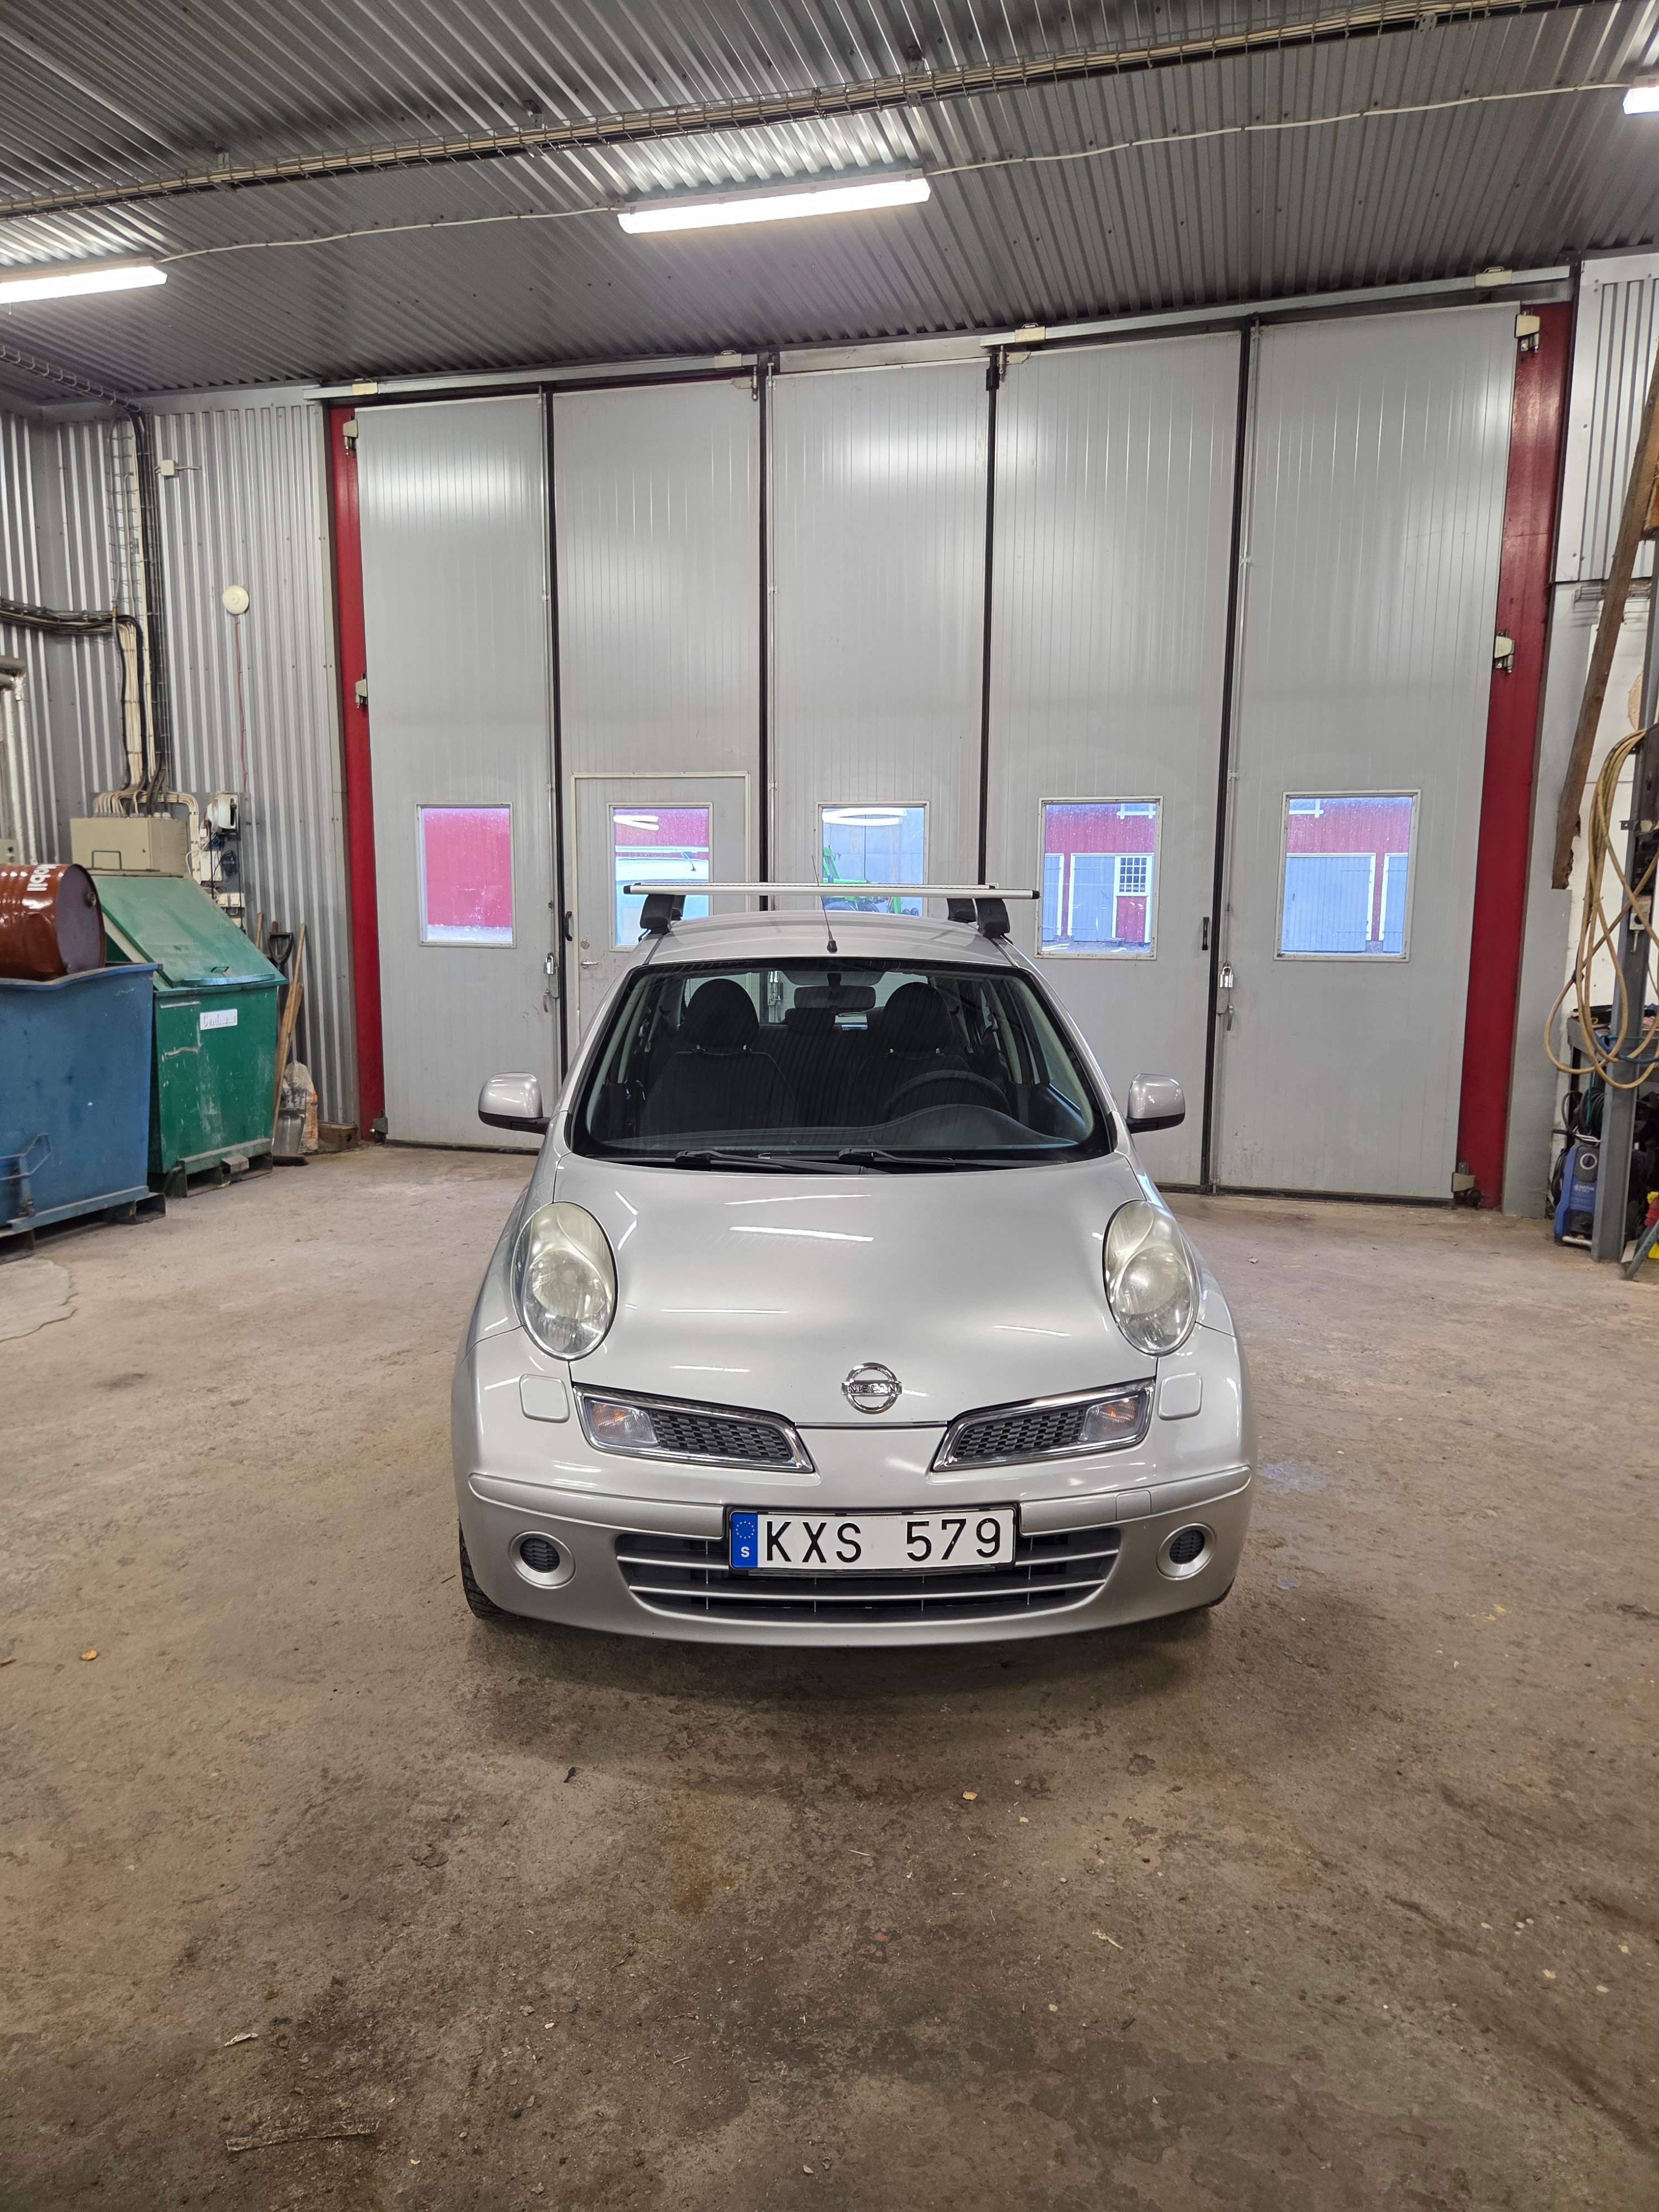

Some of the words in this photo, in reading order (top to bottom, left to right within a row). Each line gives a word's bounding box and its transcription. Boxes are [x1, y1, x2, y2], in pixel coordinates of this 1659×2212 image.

[847, 1384, 897, 1394] NISSAN
[766, 1521, 862, 1563] KXS
[906, 1517, 1001, 1562] 579
[740, 1546, 750, 1558] S
